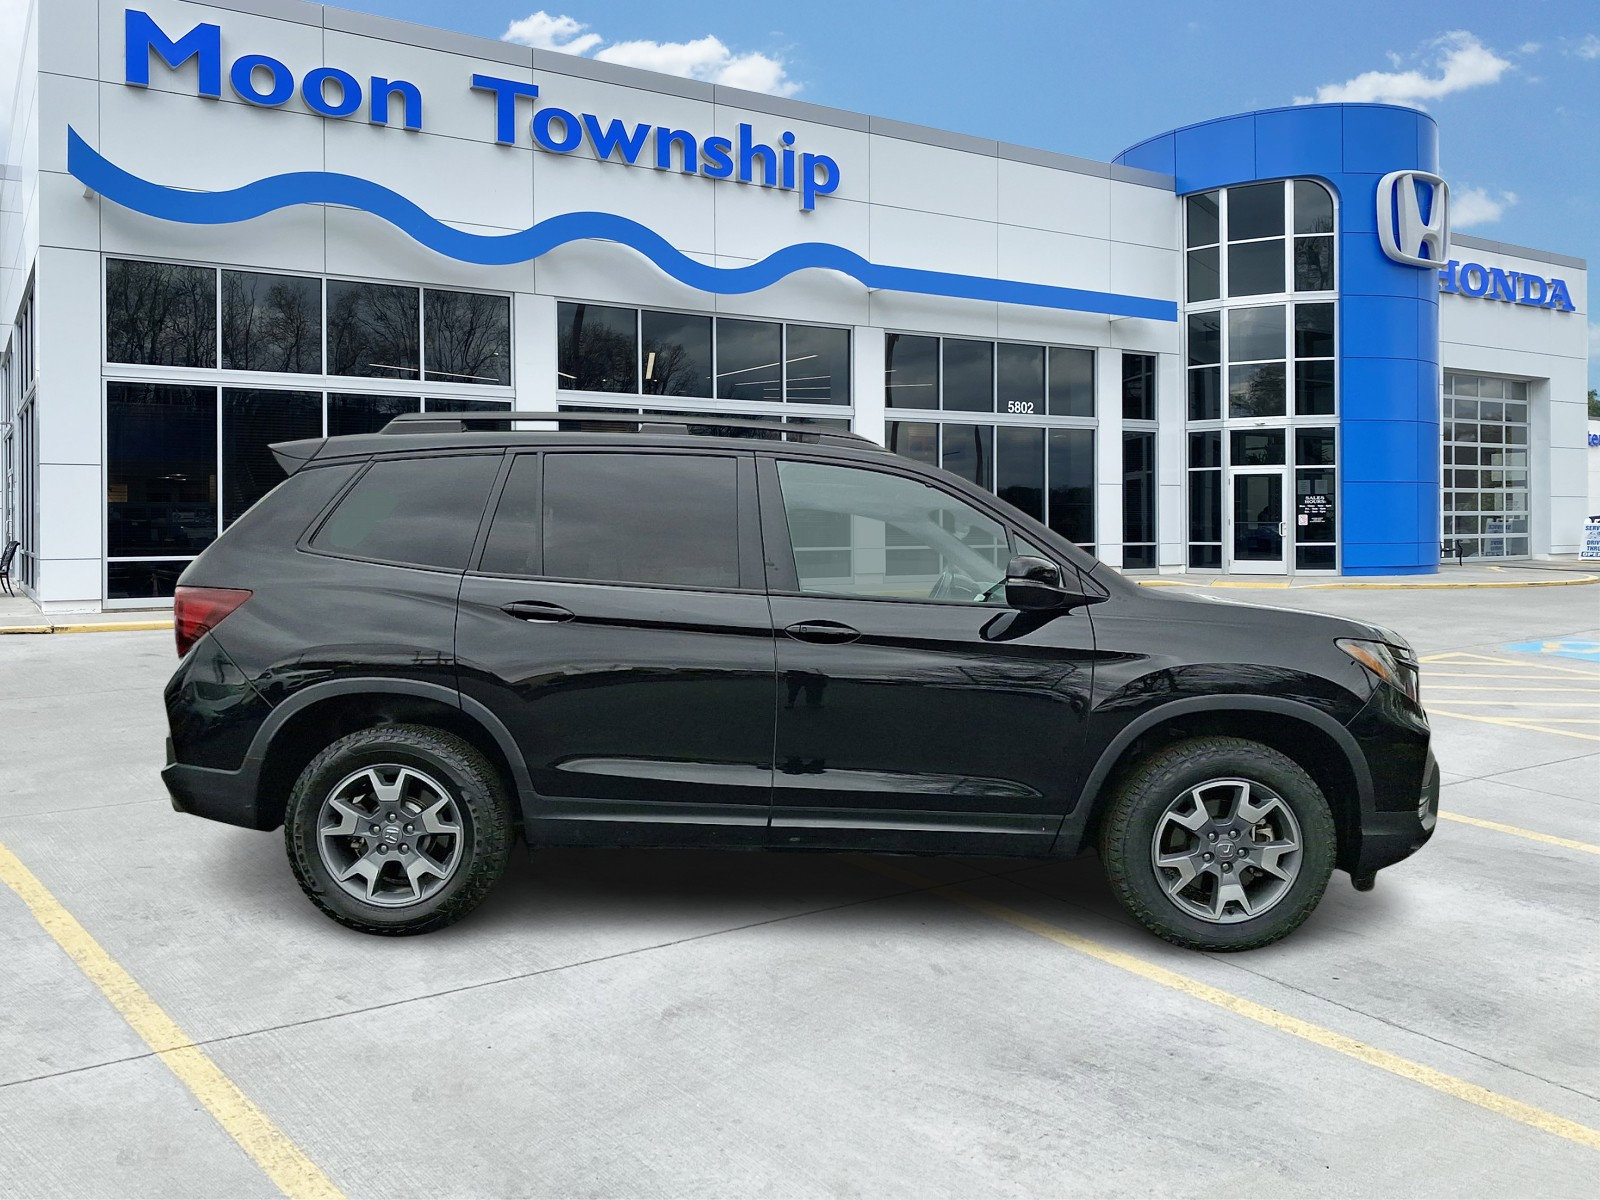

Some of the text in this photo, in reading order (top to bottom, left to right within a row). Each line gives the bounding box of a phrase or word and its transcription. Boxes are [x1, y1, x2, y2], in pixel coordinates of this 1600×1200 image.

[125, 9, 840, 212] Moon Township
[1007, 400, 1034, 414] 5802
